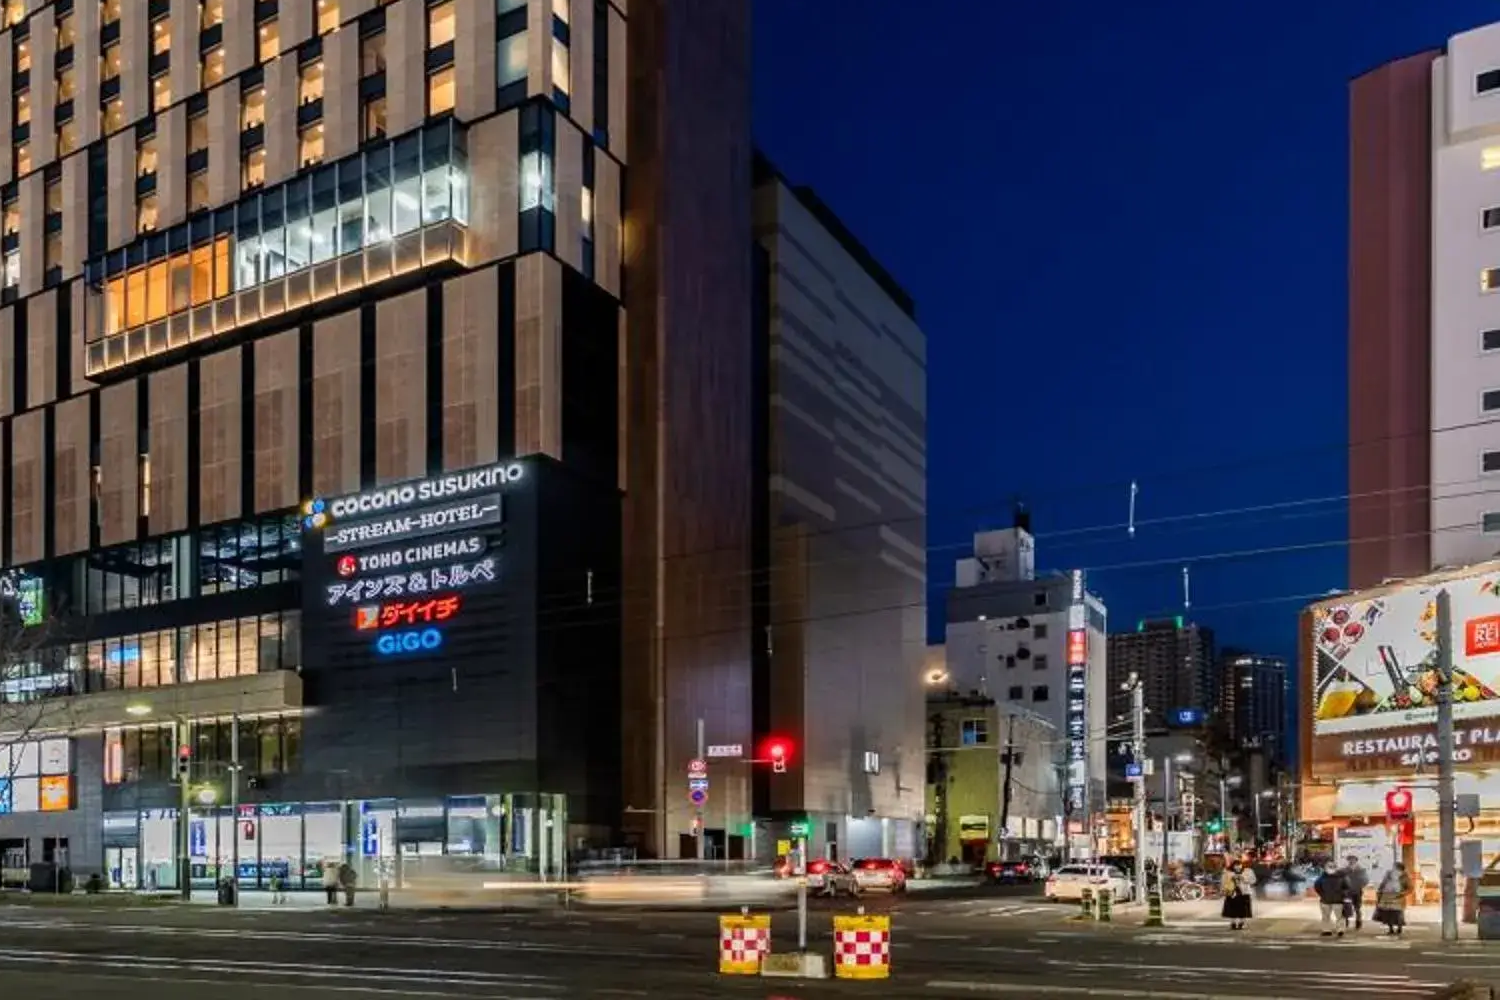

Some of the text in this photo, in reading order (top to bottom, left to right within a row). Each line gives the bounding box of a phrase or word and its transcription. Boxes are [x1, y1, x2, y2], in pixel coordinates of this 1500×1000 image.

[359, 537, 481, 571] TOHO CINEMAS
[1343, 731, 1466, 757] RESTAURAT
